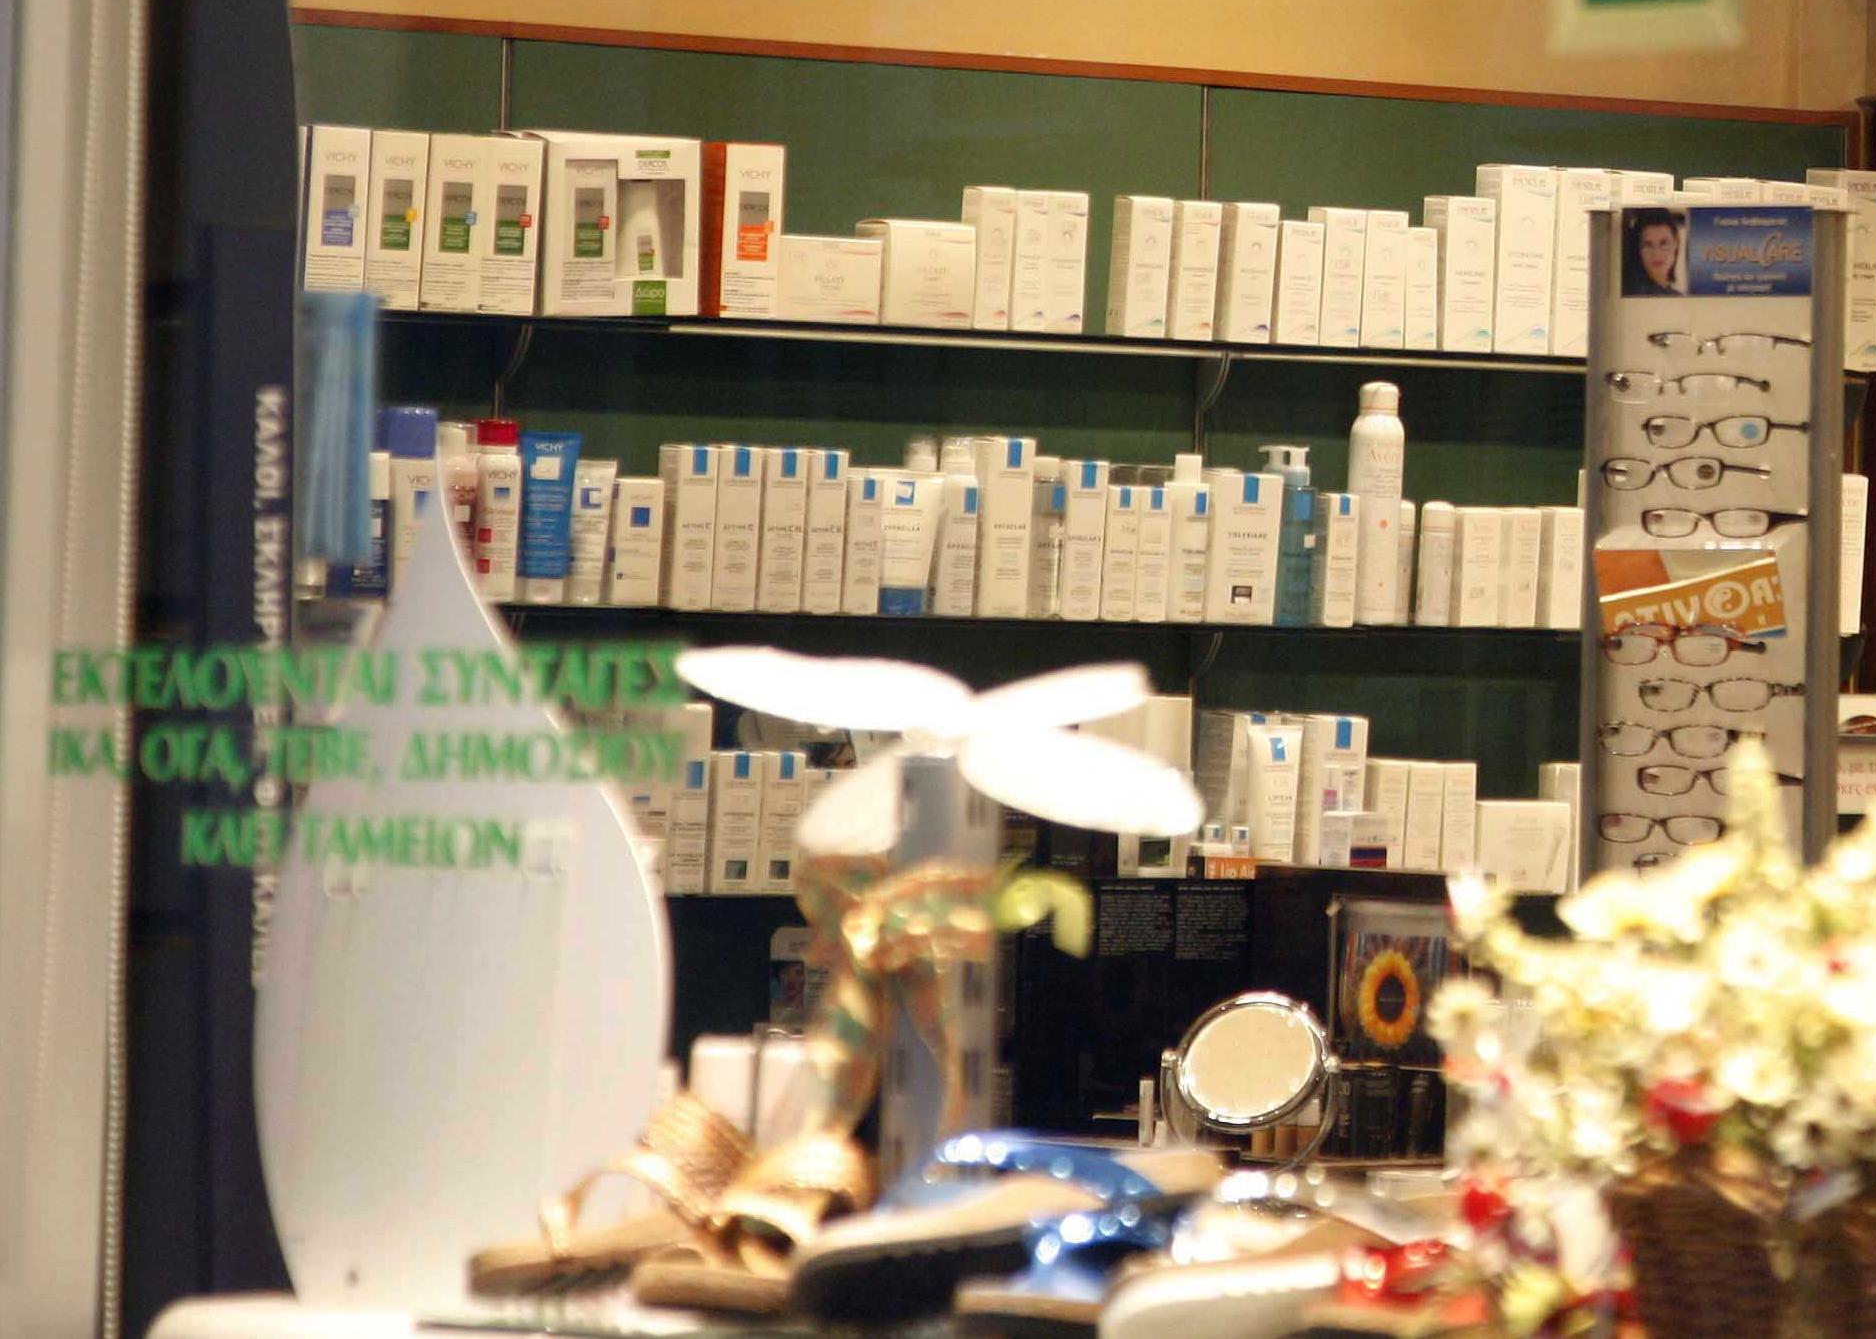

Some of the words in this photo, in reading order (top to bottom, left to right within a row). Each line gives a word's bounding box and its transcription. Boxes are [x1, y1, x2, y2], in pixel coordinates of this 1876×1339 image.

[407, 472, 436, 486] VICH
[50, 645, 398, 709] ΕΚΤΕΛΟΥΝΤΑΙ
[415, 643, 685, 706] ΣΥΝΤΑΓΕΣ
